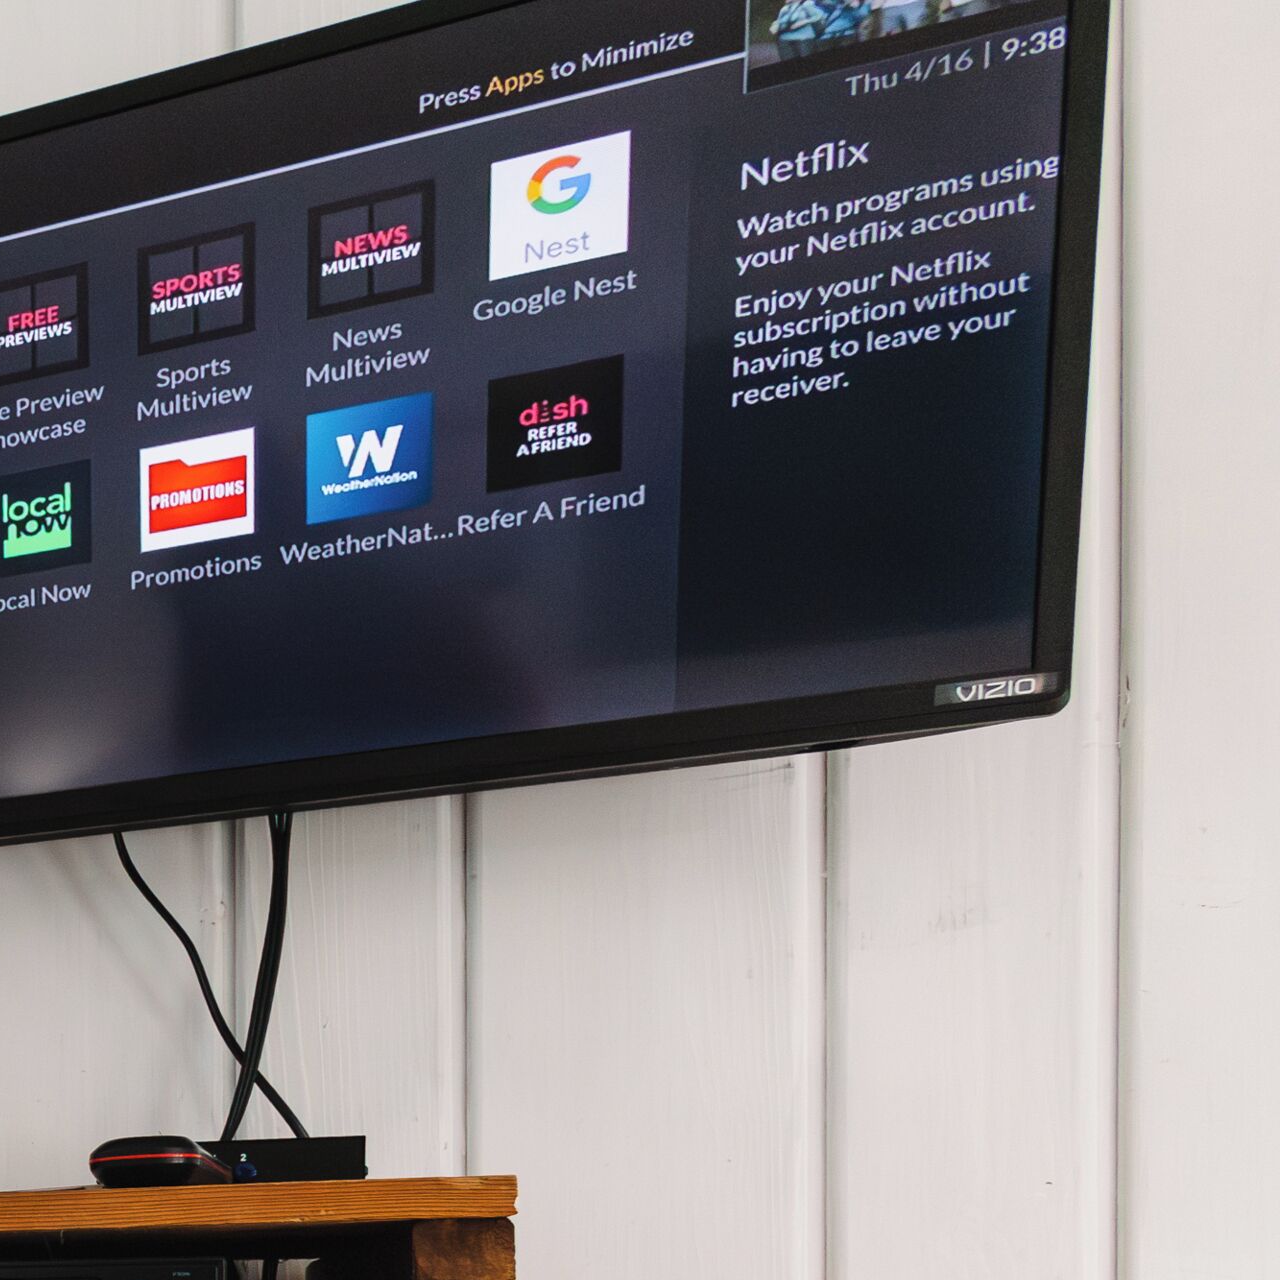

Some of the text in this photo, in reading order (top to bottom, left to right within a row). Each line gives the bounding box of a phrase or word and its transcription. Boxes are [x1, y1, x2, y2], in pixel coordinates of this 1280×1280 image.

[419, 30, 694, 114] Press Apps to Minimize
[844, 69, 898, 97] Thu
[904, 48, 974, 83] 4/16
[740, 138, 872, 192] Netflix
[736, 154, 1061, 240] Watch programs using
[333, 224, 410, 258] NEWS
[524, 230, 591, 264] Nest
[735, 190, 1035, 276] your Netflix account.
[321, 241, 422, 277] MULTIVIEW
[149, 282, 243, 316] MULTIVIEW
[151, 263, 242, 300] SPORTS
[473, 269, 638, 322] Google Nest
[734, 249, 992, 318] Enjoy your Netflix
[7, 305, 60, 333] FREE
[733, 272, 1032, 349] subscription without
[332, 322, 403, 352] News
[732, 308, 1017, 378] having to leave your
[156, 358, 232, 389] Sports
[305, 348, 431, 388] Multiview
[15, 385, 106, 419] Preview
[136, 384, 253, 422] Multiview
[731, 371, 850, 408] receiver.
[518, 394, 589, 428] dish
[515, 431, 592, 459] A FRIEND
[527, 420, 578, 441] REFER
[150, 479, 245, 512] PROMOTIONS
[321, 470, 418, 496] WeatherNation
[2, 481, 72, 523] local
[457, 484, 646, 537] Refer A Friend
[130, 553, 262, 591] Promotions
[41, 582, 92, 606] Now
[955, 677, 1036, 702] VIZIO
[240, 1153, 247, 1162] 2
